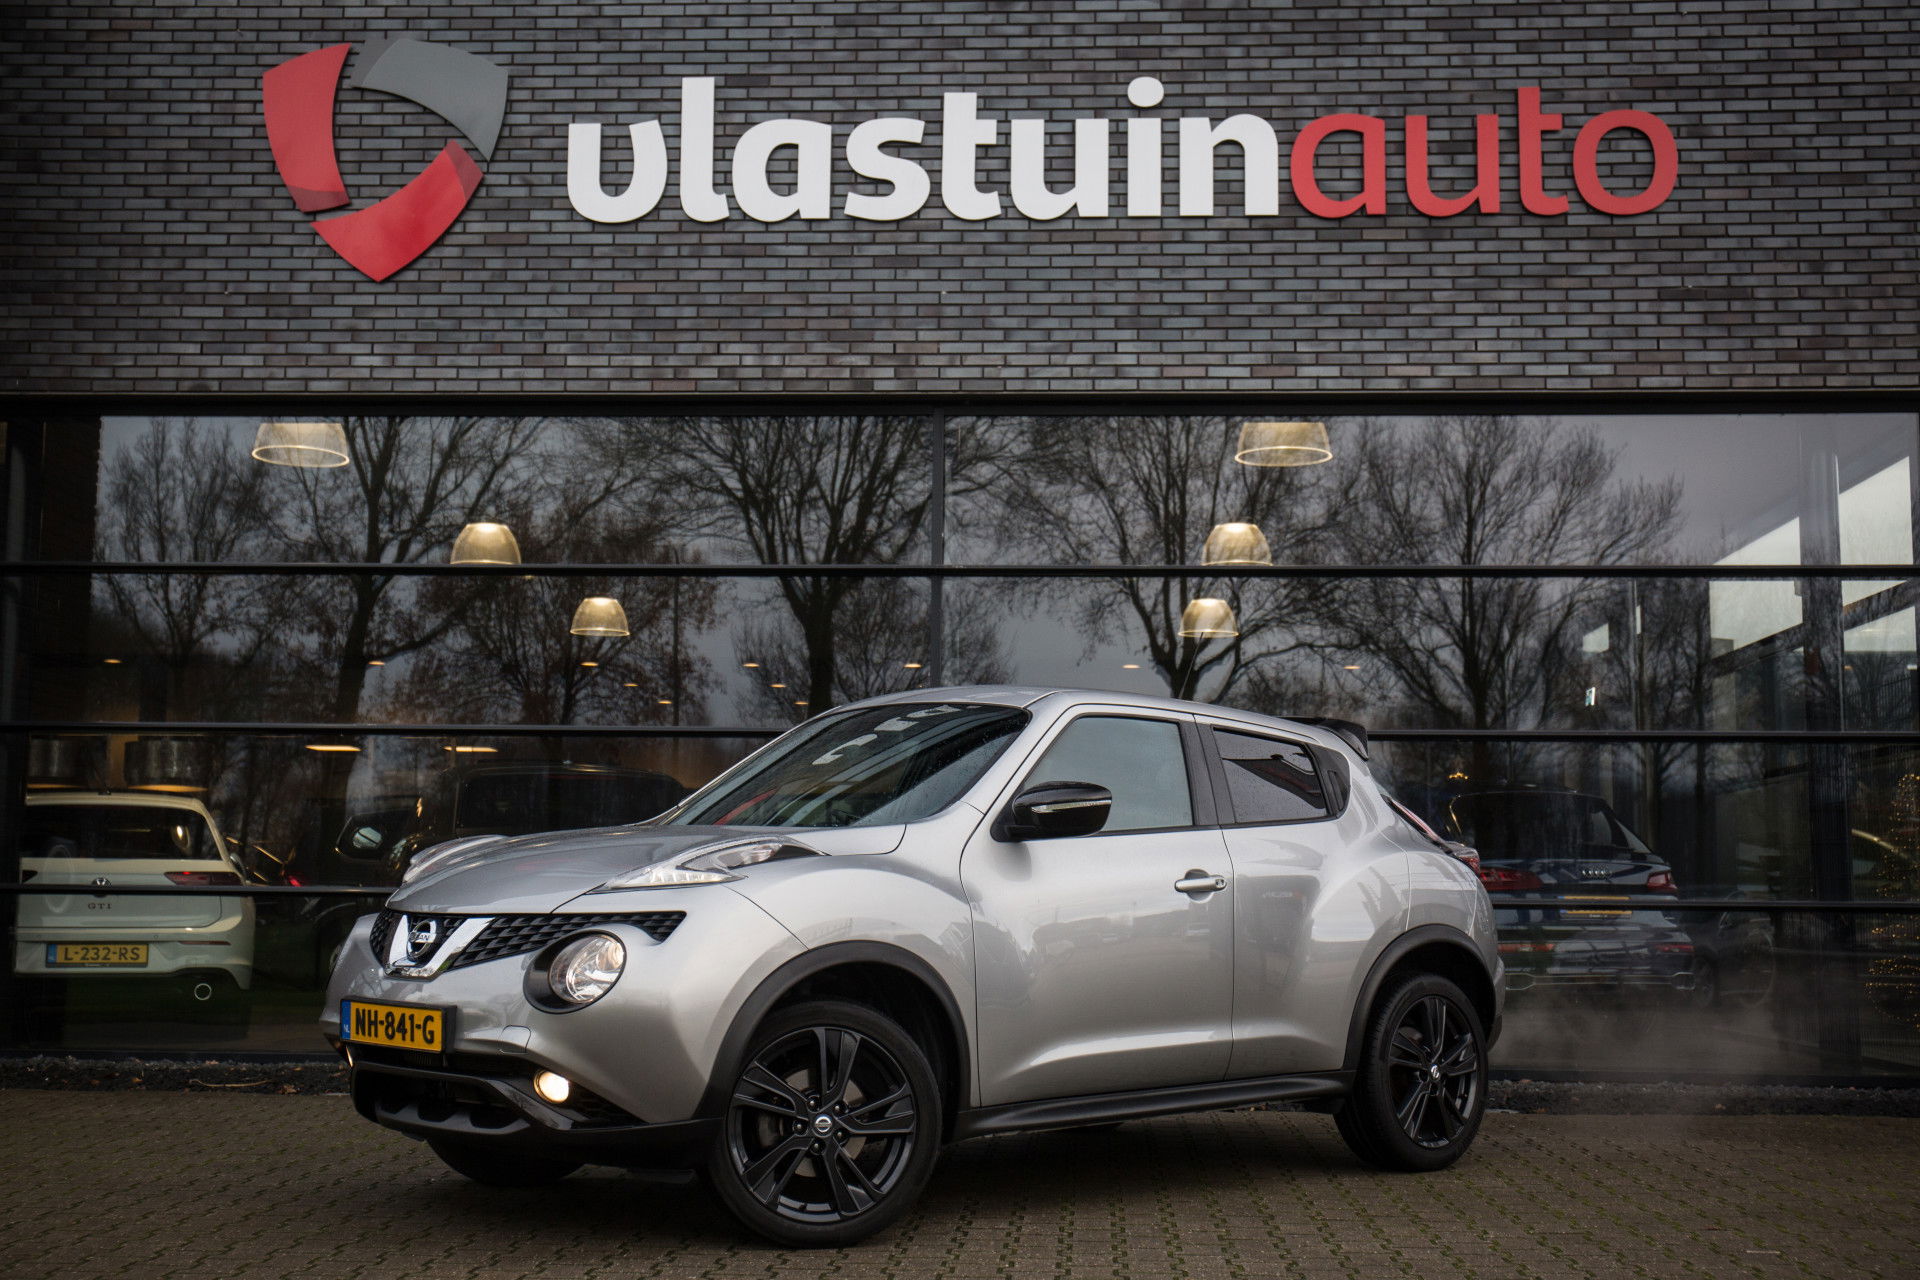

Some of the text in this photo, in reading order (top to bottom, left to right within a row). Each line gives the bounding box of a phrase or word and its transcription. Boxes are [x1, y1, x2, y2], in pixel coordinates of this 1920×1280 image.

[87, 902, 113, 910] GTI
[63, 947, 140, 961] L-232-RS
[355, 1007, 435, 1045] NH-841-G
